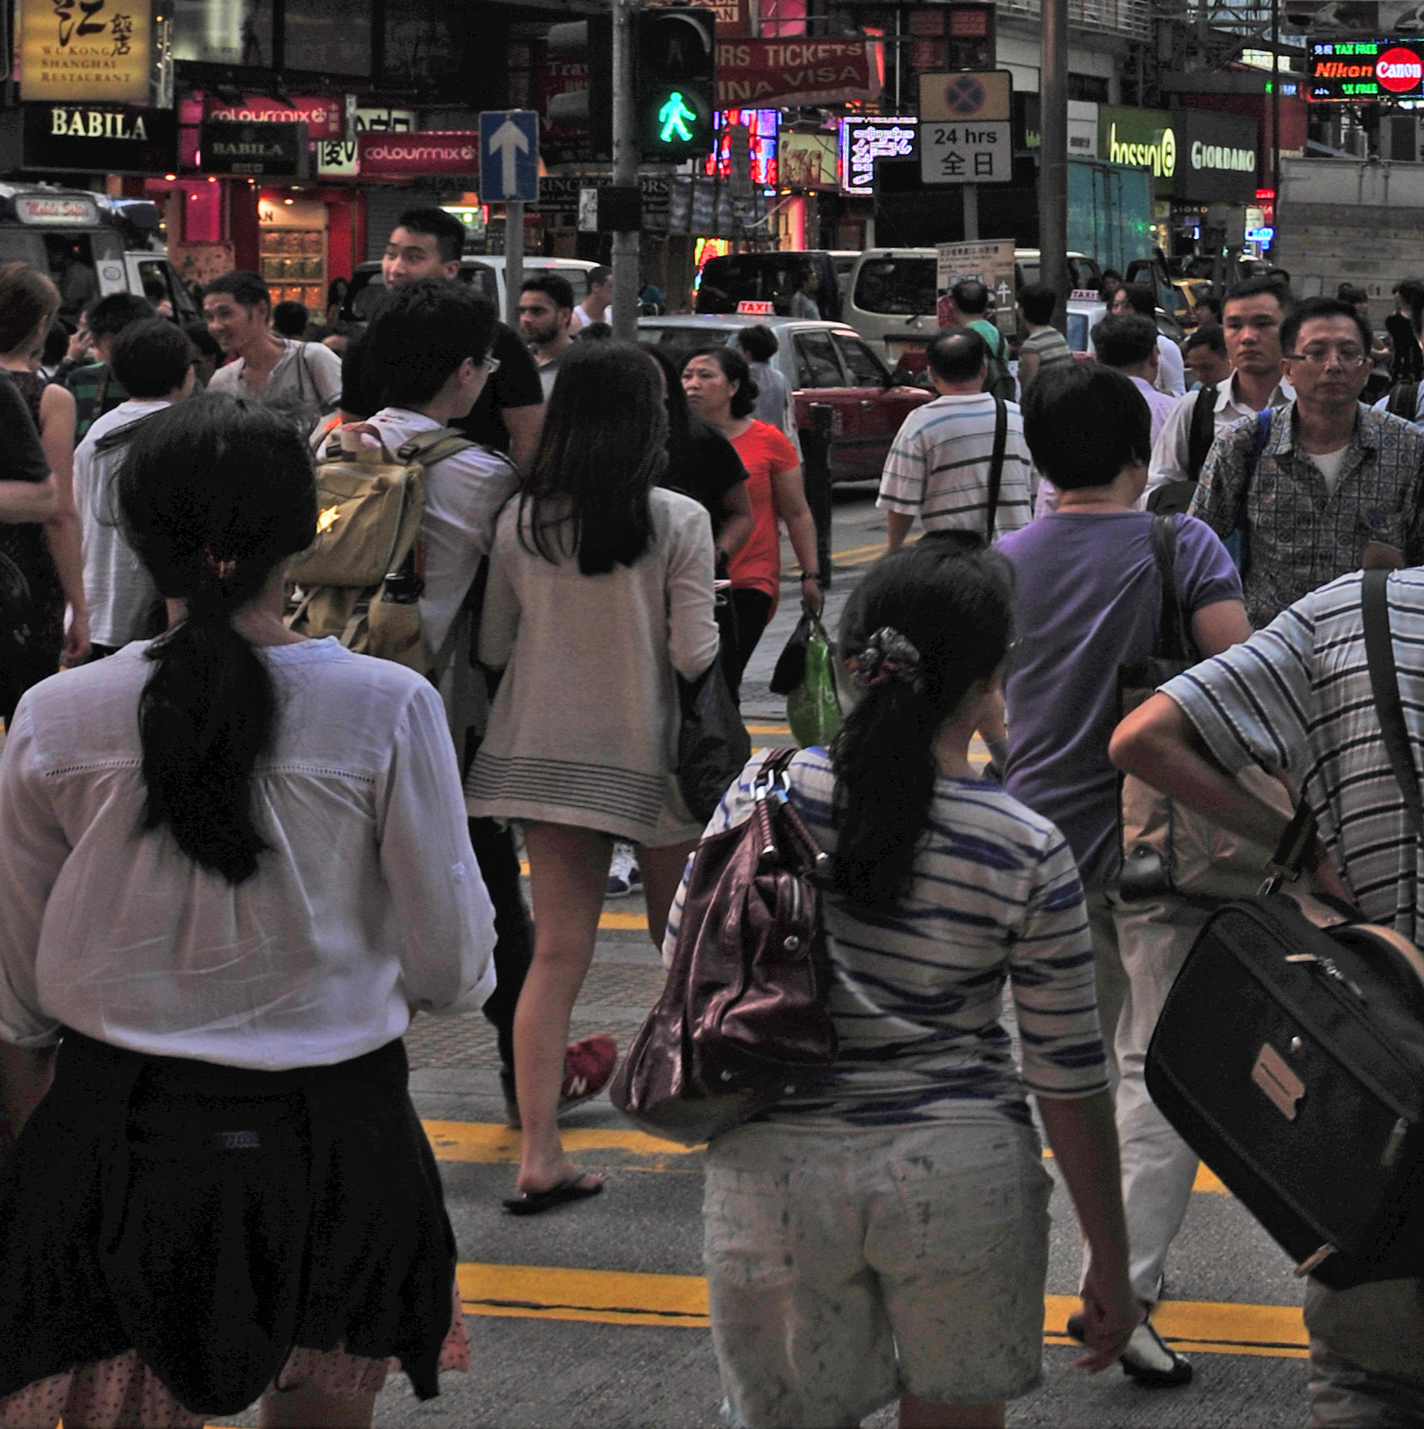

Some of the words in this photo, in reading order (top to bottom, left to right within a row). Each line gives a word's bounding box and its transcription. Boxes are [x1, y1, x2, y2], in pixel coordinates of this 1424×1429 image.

[764, 42, 863, 67] TICKETS
[1334, 44, 1354, 54] TAX
[1355, 43, 1378, 54] FREE
[41, 59, 117, 69] SHANGHAI
[1314, 62, 1374, 78] Nikon
[1376, 61, 1423, 78] Canon
[41, 72, 131, 83] RESTAURANT
[782, 66, 861, 88] VISA
[1355, 83, 1378, 94] FREE
[51, 108, 148, 141] BABILA
[934, 129, 957, 145] 24
[965, 128, 997, 144] hrs
[212, 142, 283, 156] BABILA
[364, 144, 460, 160] colourmix
[1191, 141, 1255, 172] GIORDANO
[941, 151, 994, 176] 全日
[1072, 290, 1098, 300] TAXI
[740, 301, 770, 313] TAXI
